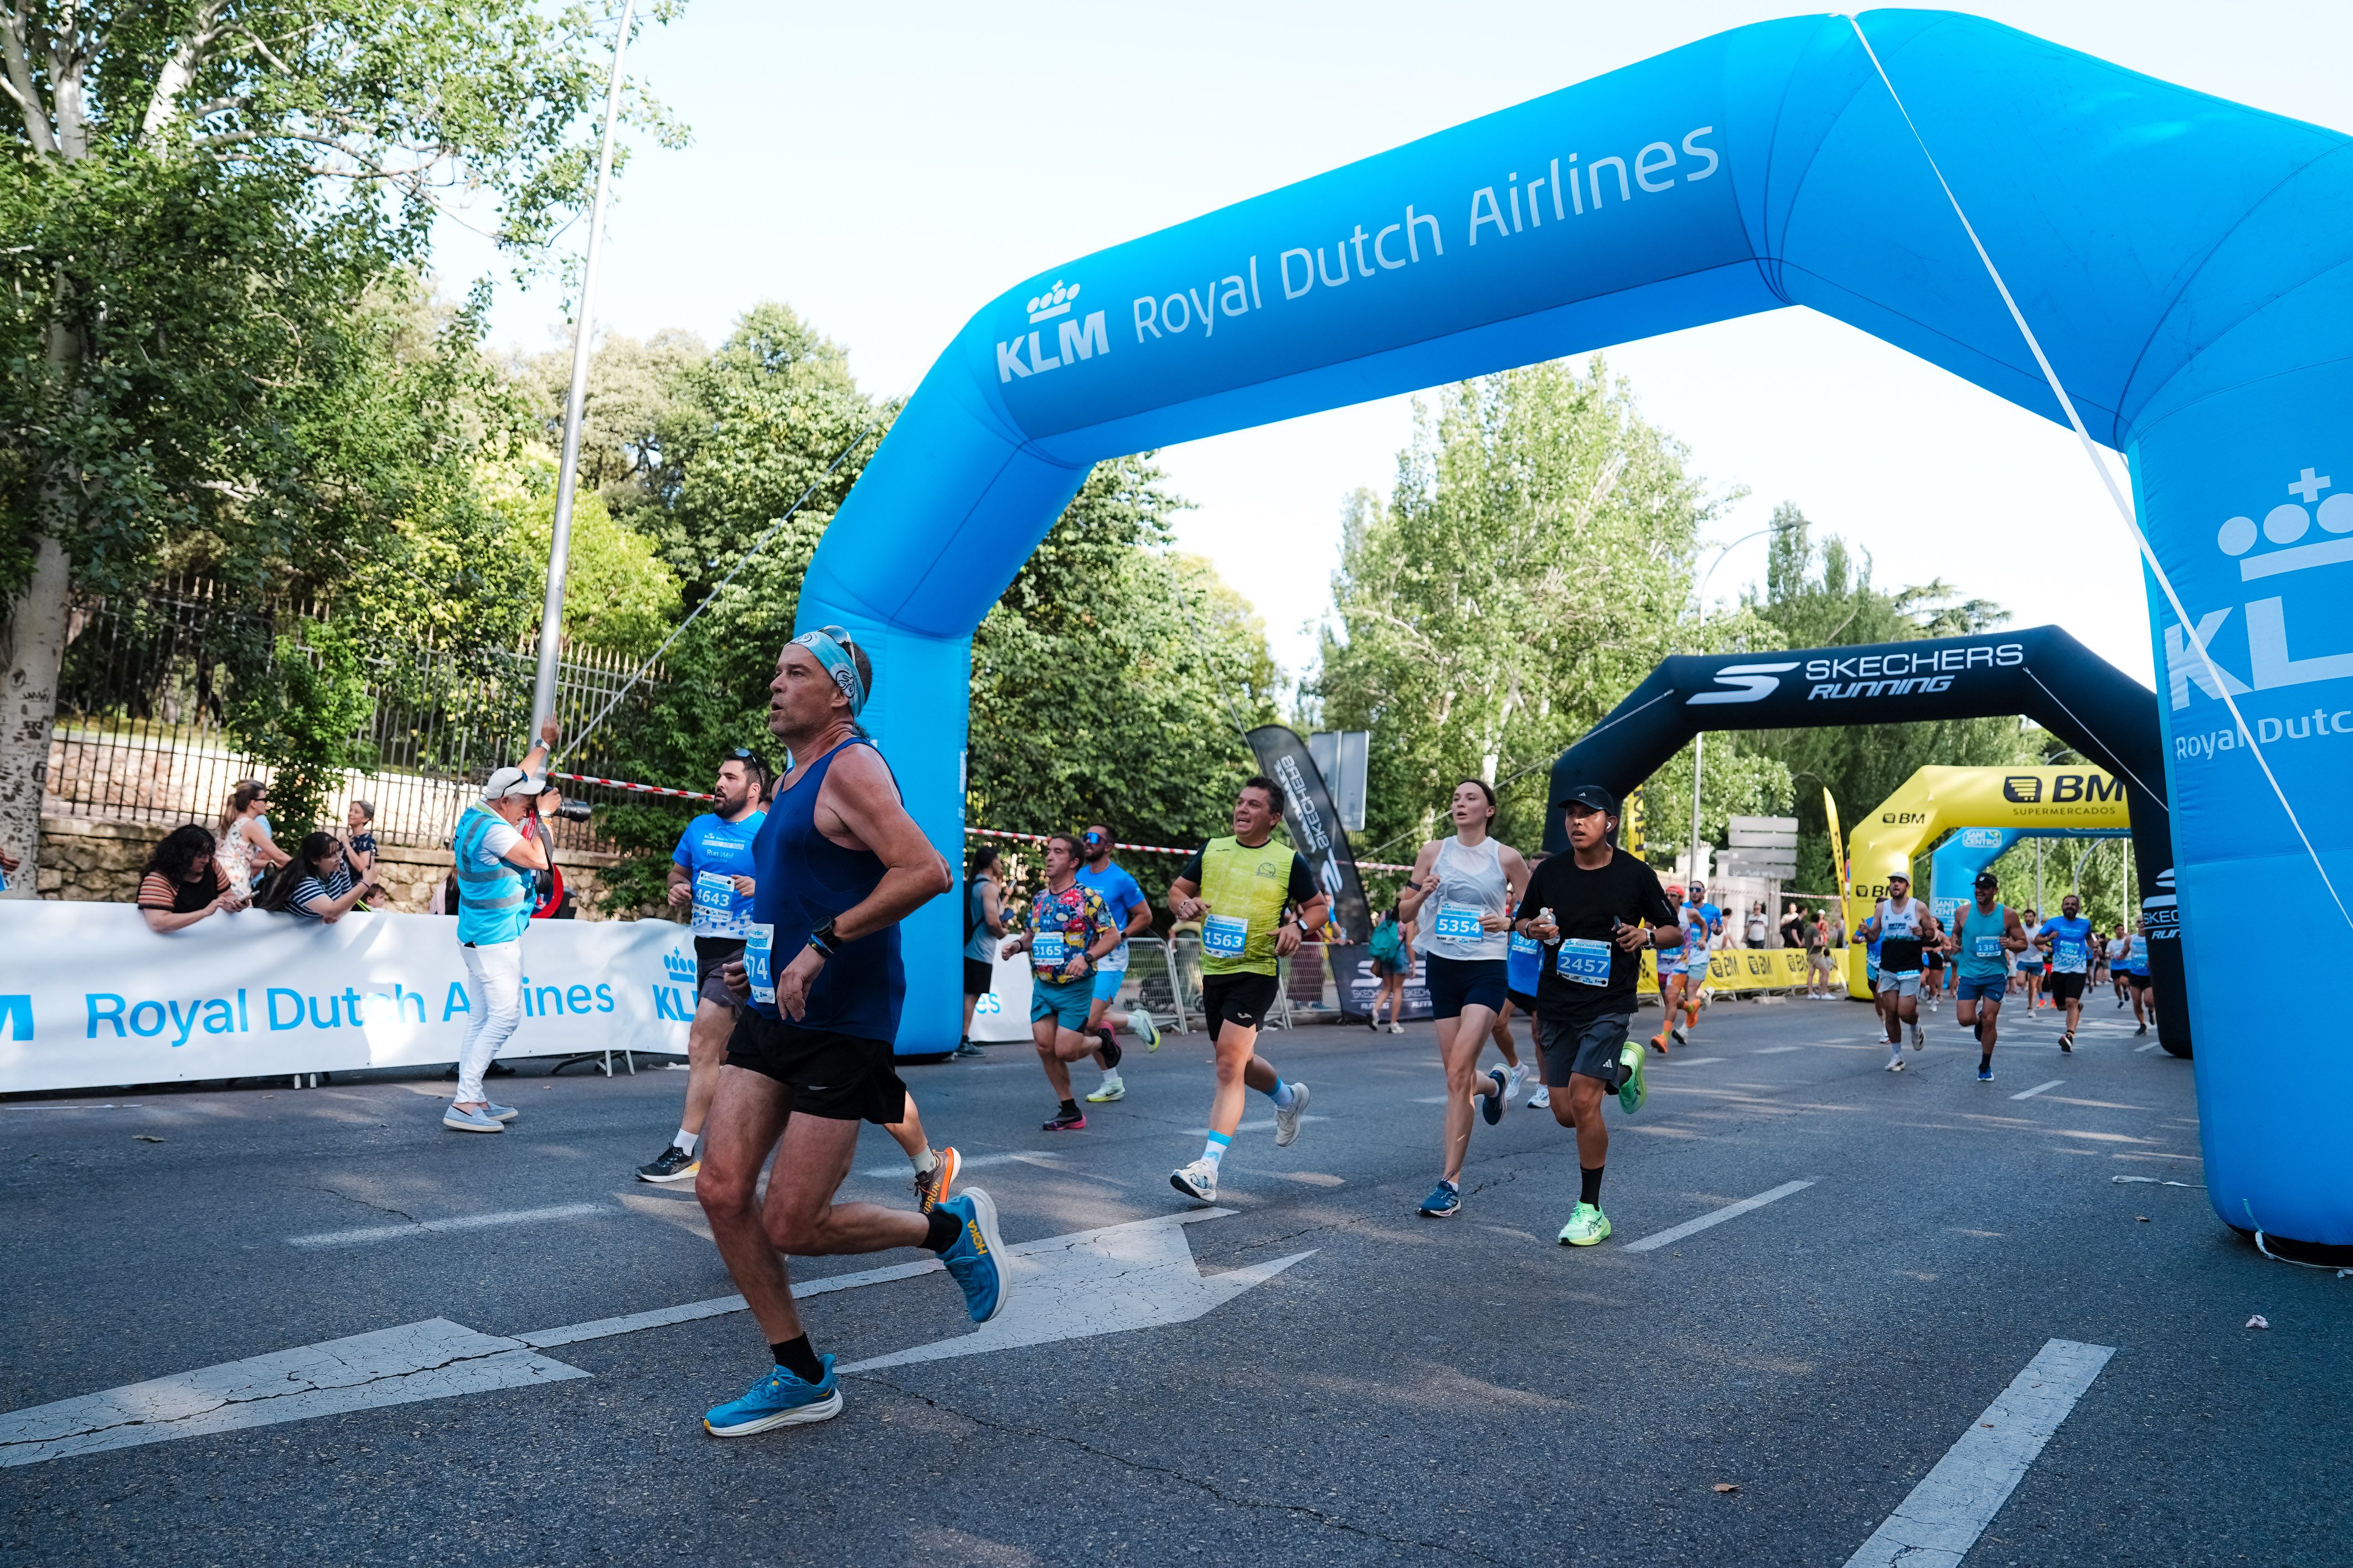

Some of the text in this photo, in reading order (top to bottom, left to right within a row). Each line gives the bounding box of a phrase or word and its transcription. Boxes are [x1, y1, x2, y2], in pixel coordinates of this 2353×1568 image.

[997, 125, 1720, 384] KLM Royal Dutch Airlines
[1805, 643, 2024, 681] SKECHERS
[2164, 595, 2353, 712] KL
[1807, 675, 1955, 701] RUNNING
[2176, 708, 2353, 760] Royal Dutc
[2052, 774, 2125, 803] BM
[1899, 813, 1925, 824] BM
[2013, 806, 2115, 816] SUPERMERCADOS
[1964, 837, 1998, 847] CENTRO
[706, 849, 719, 857] Run
[696, 888, 730, 907] 4643
[1438, 918, 1480, 934] 5354
[2143, 909, 2179, 925] SKEC
[1205, 931, 1243, 948] 1563
[1033, 945, 1062, 956] 3165
[745, 953, 768, 980] 574
[1560, 956, 1608, 974] 2457
[86, 989, 249, 1047] Royal
[442, 977, 615, 1022] Aines
[967, 1219, 988, 1255] HOKA
